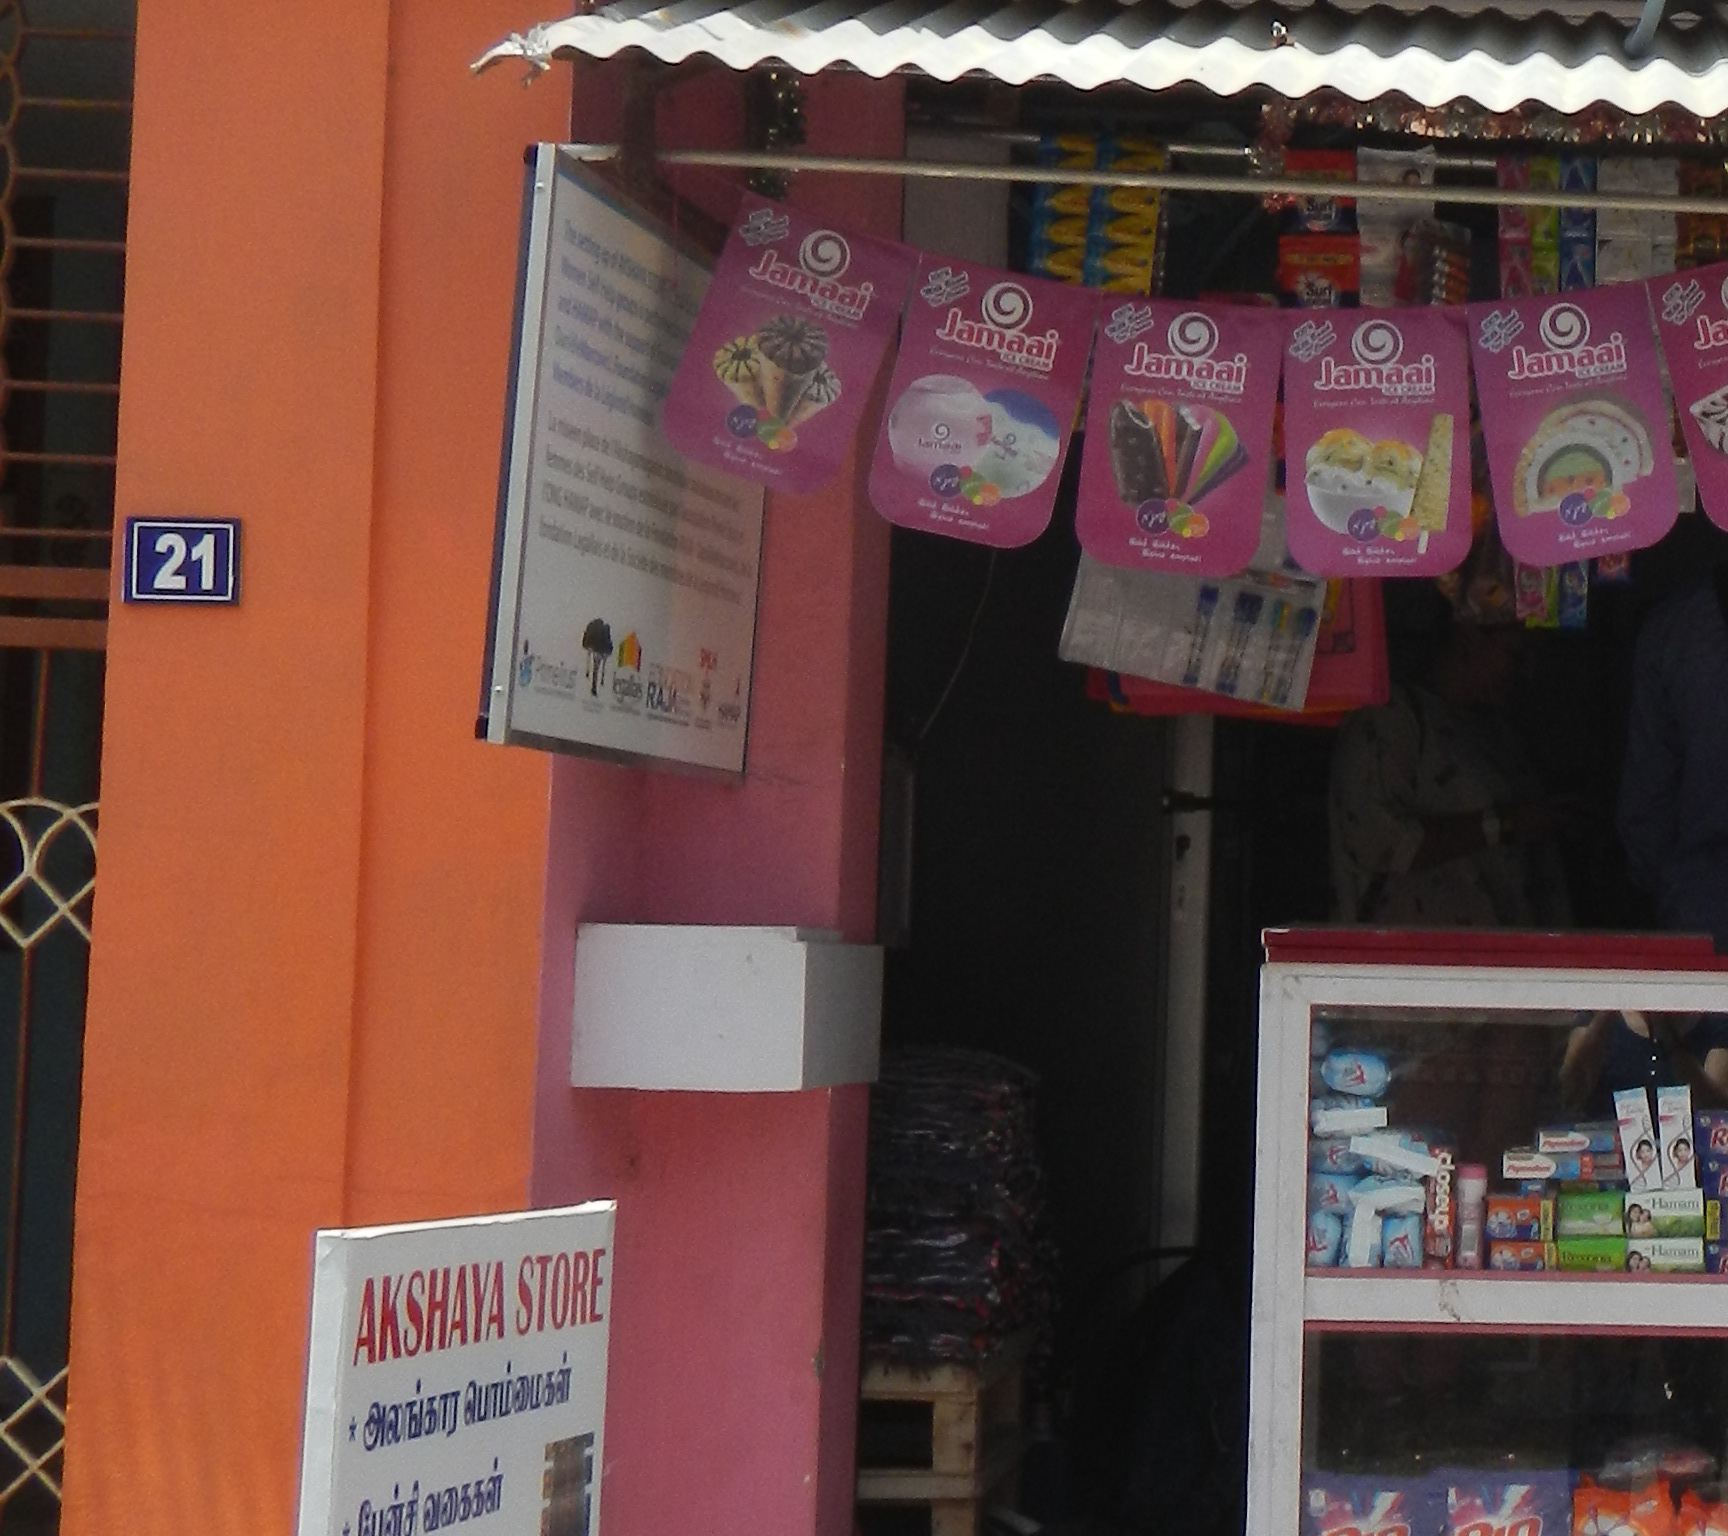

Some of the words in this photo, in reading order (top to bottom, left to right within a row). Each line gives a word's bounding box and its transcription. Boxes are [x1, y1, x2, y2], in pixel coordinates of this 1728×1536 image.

[749, 249, 874, 312] Jamaai
[936, 306, 1059, 361] Jamaai
[1508, 332, 1627, 381] Jamaai
[1124, 342, 1247, 384] Jamaai
[1314, 354, 1436, 391] Jamaai
[153, 532, 215, 590] 21
[1652, 1198, 1700, 1210] Hamam
[353, 1261, 504, 1367] AKSHAYA
[516, 1248, 606, 1337] STORE
